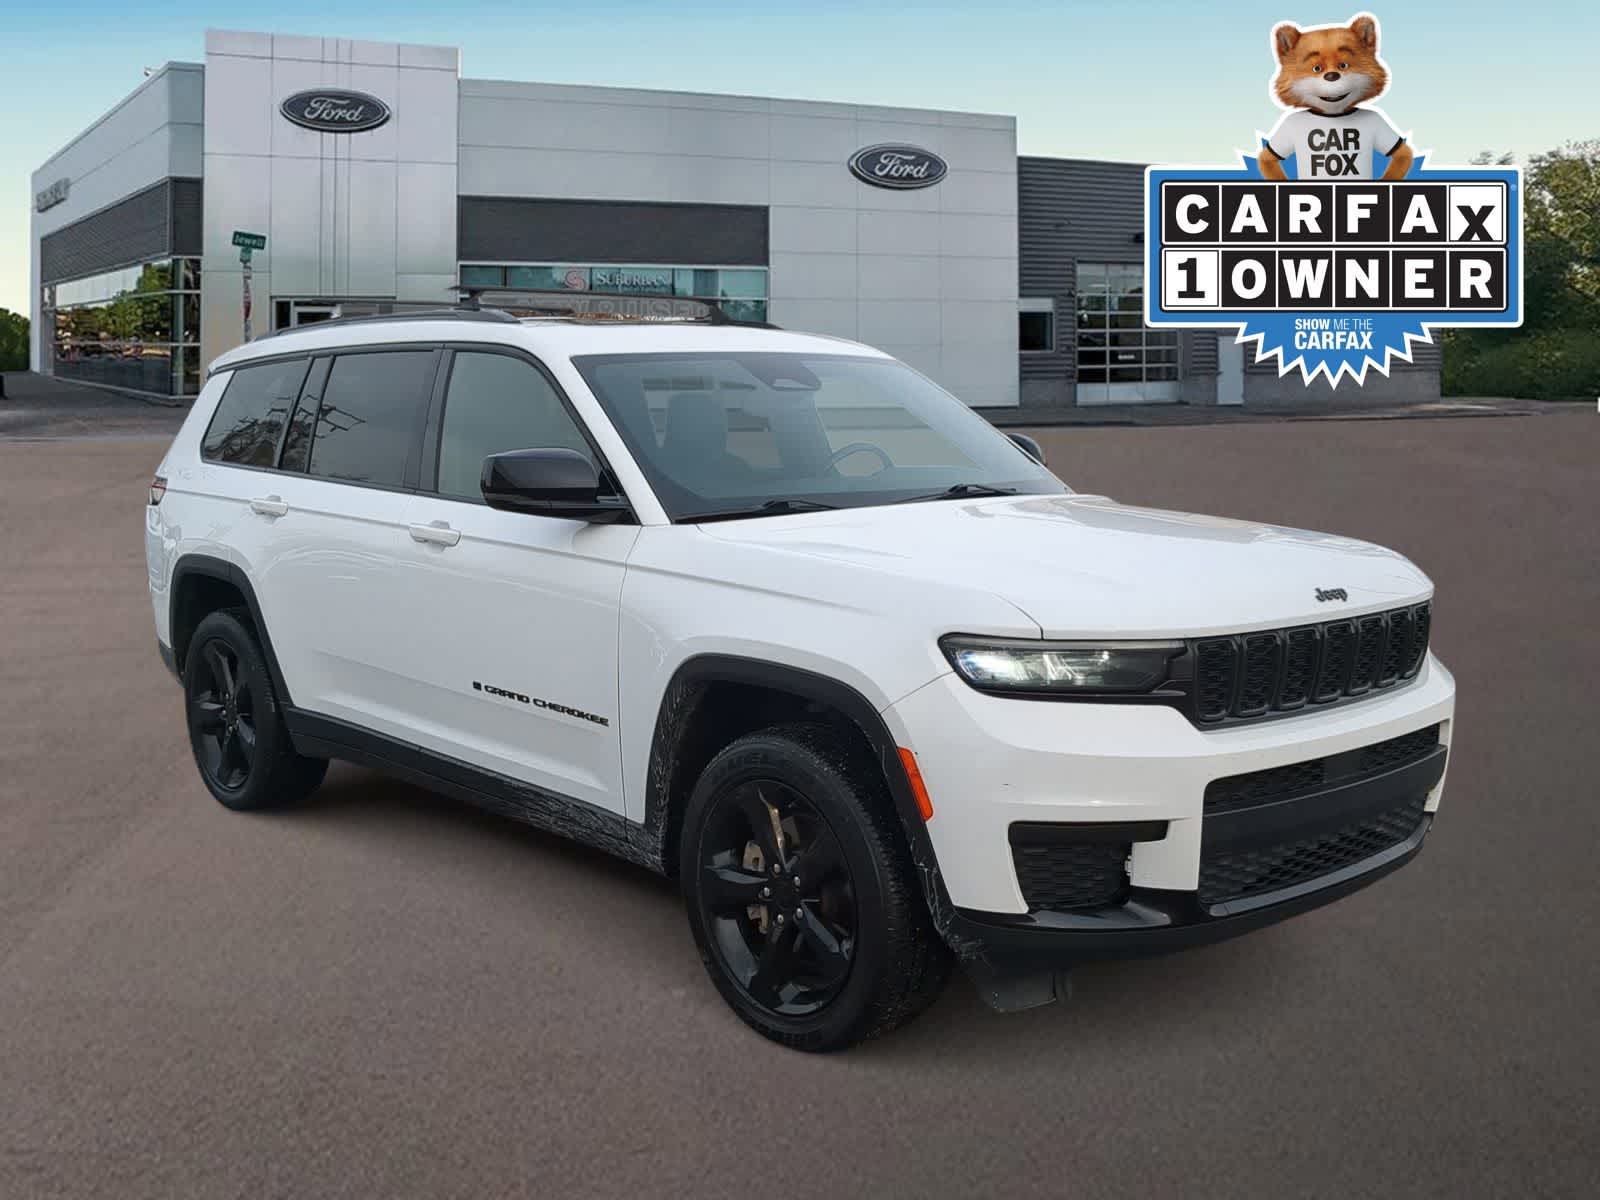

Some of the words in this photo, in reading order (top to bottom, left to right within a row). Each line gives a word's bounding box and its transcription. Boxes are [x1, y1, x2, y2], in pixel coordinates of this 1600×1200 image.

[304, 97, 364, 122] Ford
[874, 152, 929, 178] Ford
[1314, 587, 1348, 602] Jeep
[484, 684, 530, 704] GRAND
[533, 698, 609, 727] CHEROKEE
